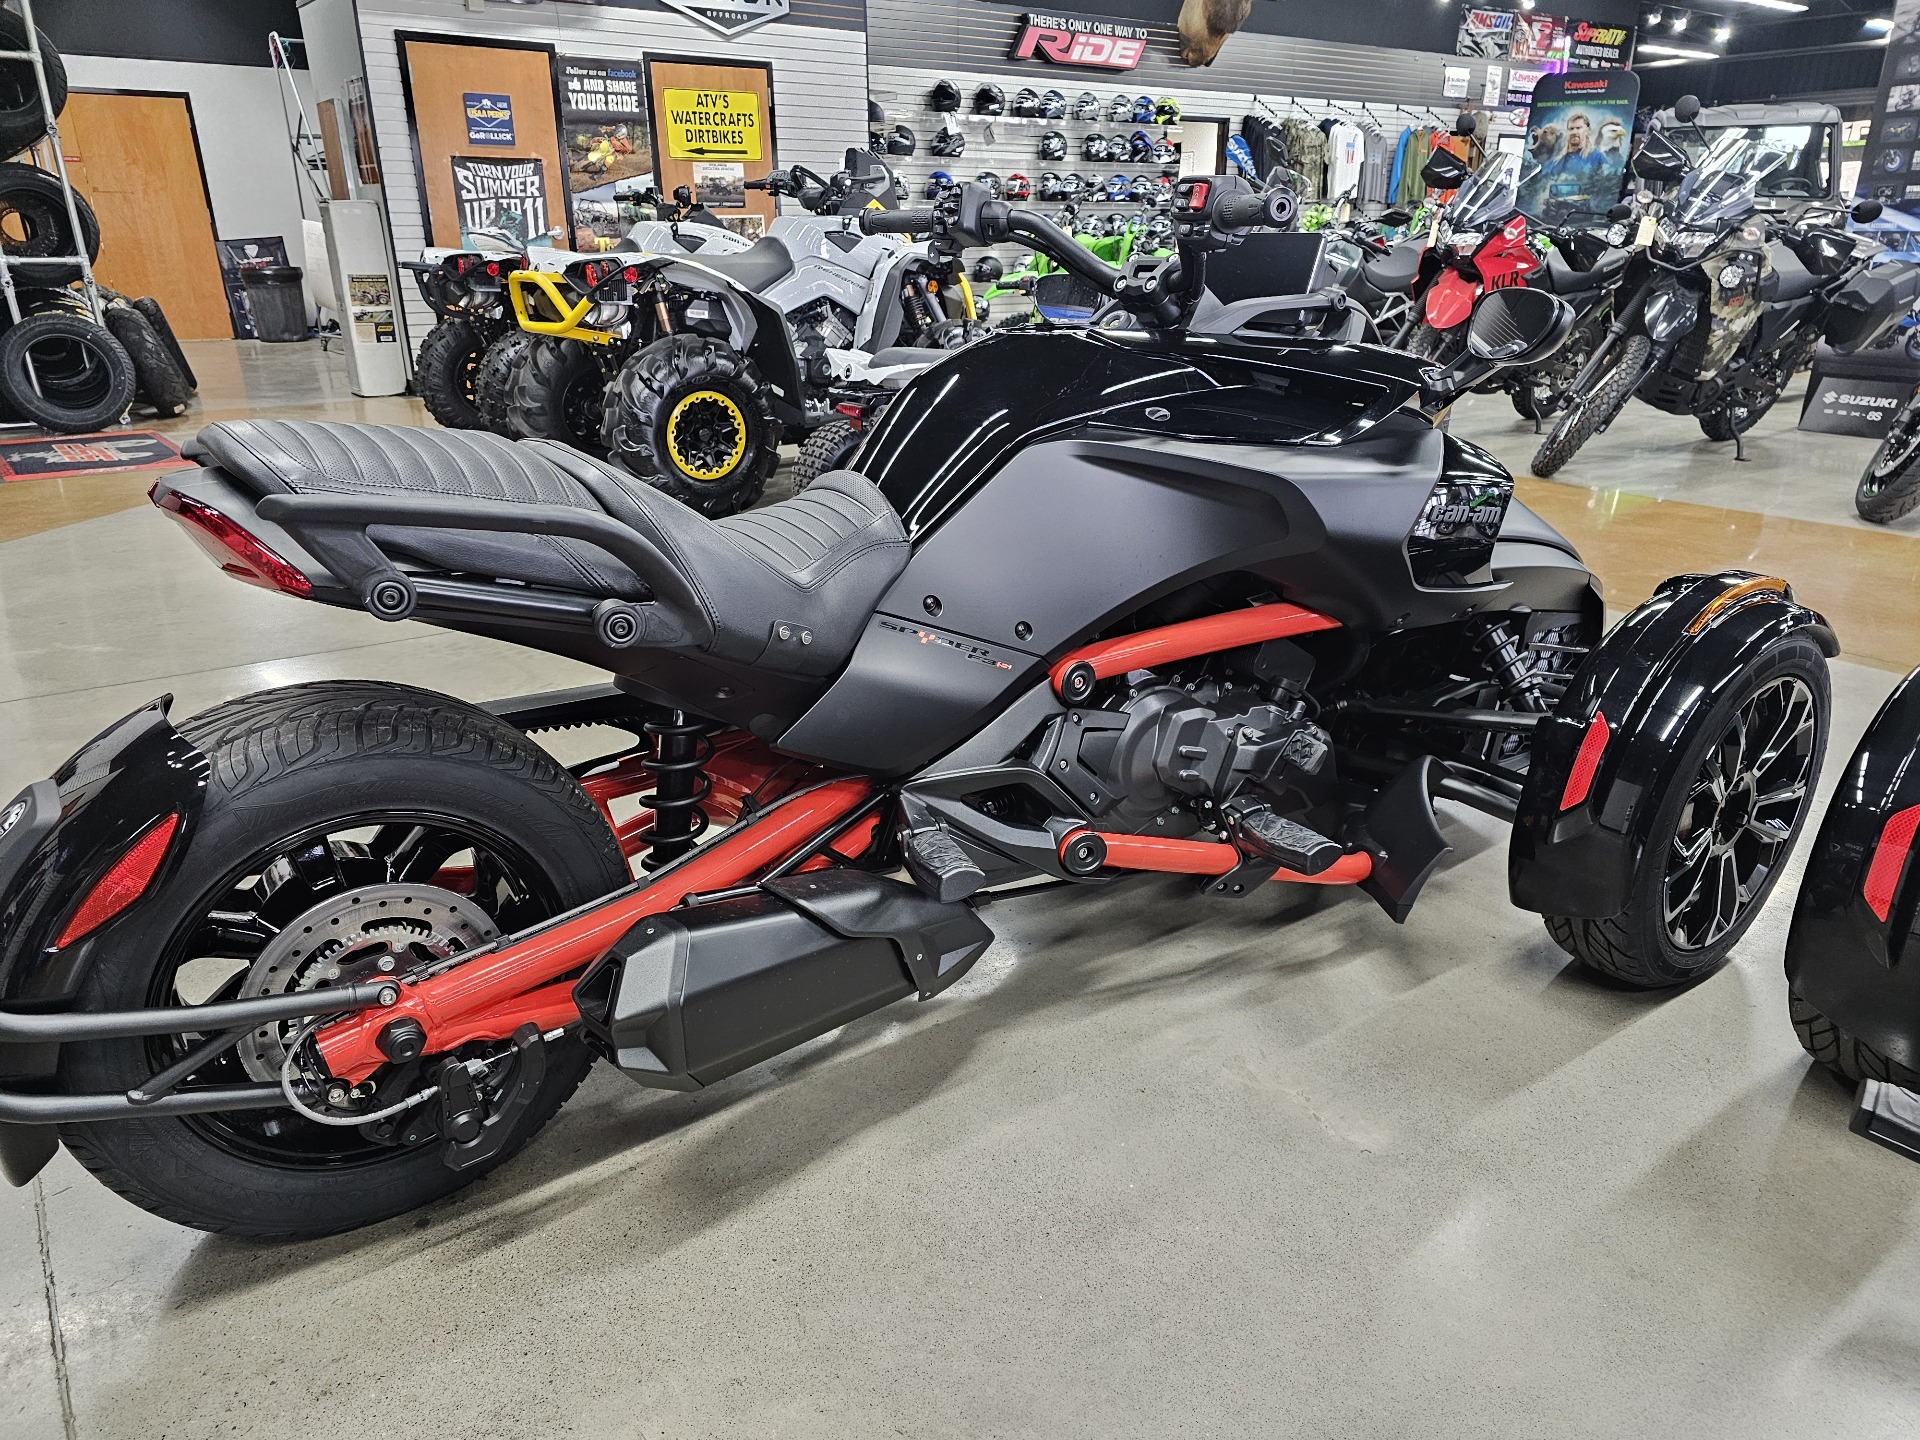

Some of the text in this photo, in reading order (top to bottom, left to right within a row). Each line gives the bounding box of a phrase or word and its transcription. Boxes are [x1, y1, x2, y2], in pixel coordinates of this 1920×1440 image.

[706, 10, 748, 20] OFFROAD
[1471, 12, 1513, 29] AMSOIL
[1028, 13, 1147, 40] THERE'S ONLY ONE WAY TO
[1576, 44, 1603, 58] AUTHORIZED
[1603, 47, 1619, 59] DEALER
[565, 66, 588, 75] Follow
[607, 68, 637, 78] facebook
[583, 78, 638, 94] AND SHARE
[1564, 79, 1608, 89] Kawasaki
[568, 92, 640, 113] YOUR RIDE
[696, 93, 729, 109] ATV'S
[469, 109, 487, 118] USAA
[670, 110, 754, 127] WATERCRAFTS
[685, 129, 744, 144] DIRTBIKES
[466, 162, 534, 180] TURN YOUR
[453, 165, 541, 200] SUMMER
[463, 199, 496, 231] UP
[522, 197, 546, 240] 11
[1491, 271, 1519, 290] KLR
[1838, 394, 1898, 408] SUZUKI
[1430, 505, 1502, 524] can-am
[879, 621, 990, 657] SPYDER
